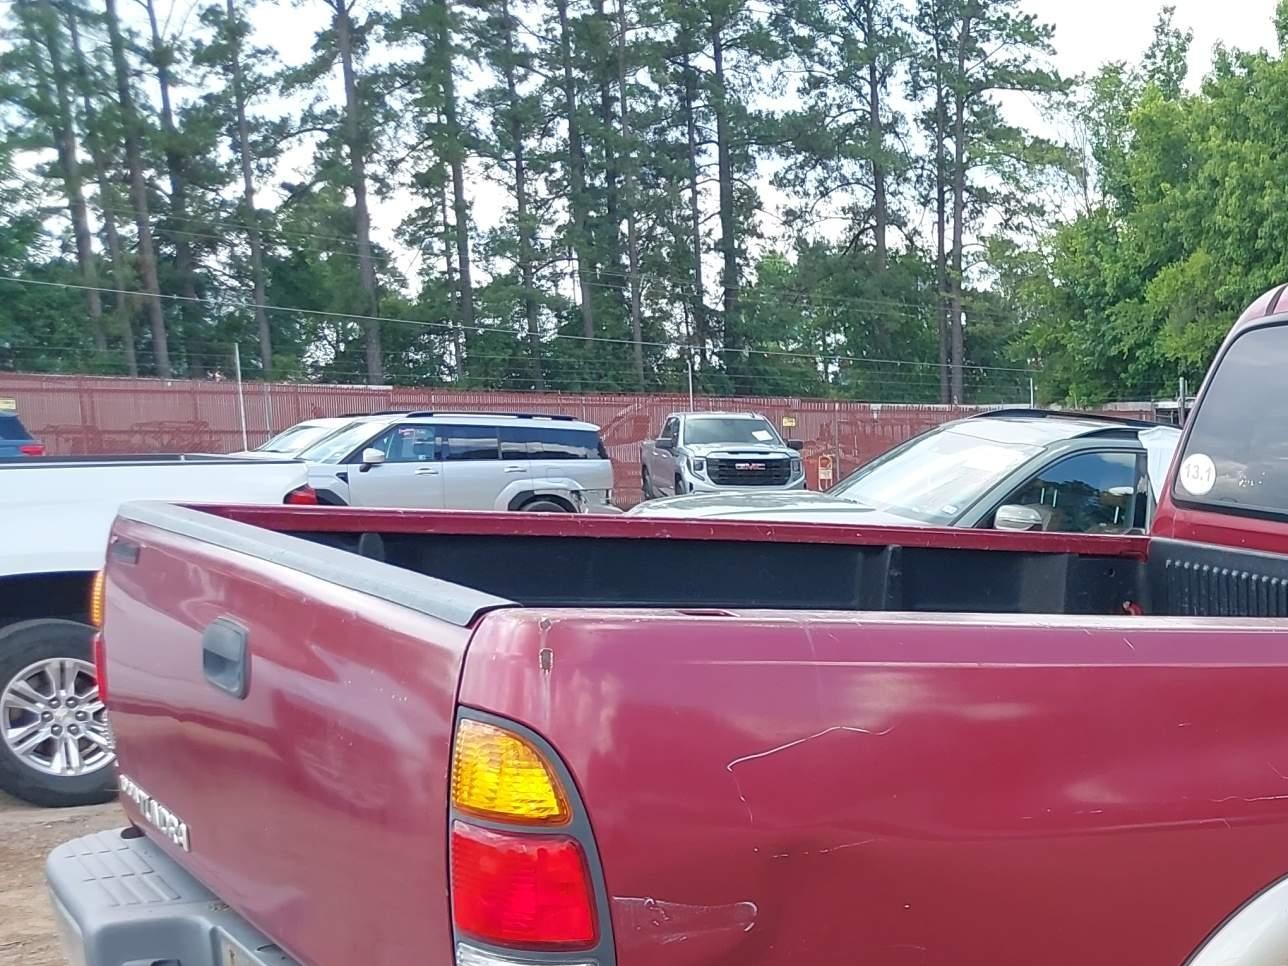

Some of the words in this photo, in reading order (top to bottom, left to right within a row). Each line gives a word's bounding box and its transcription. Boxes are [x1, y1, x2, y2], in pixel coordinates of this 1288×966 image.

[735, 463, 766, 471] GMC
[1185, 463, 1213, 482] 13.1
[139, 789, 190, 852] TUNDRA
